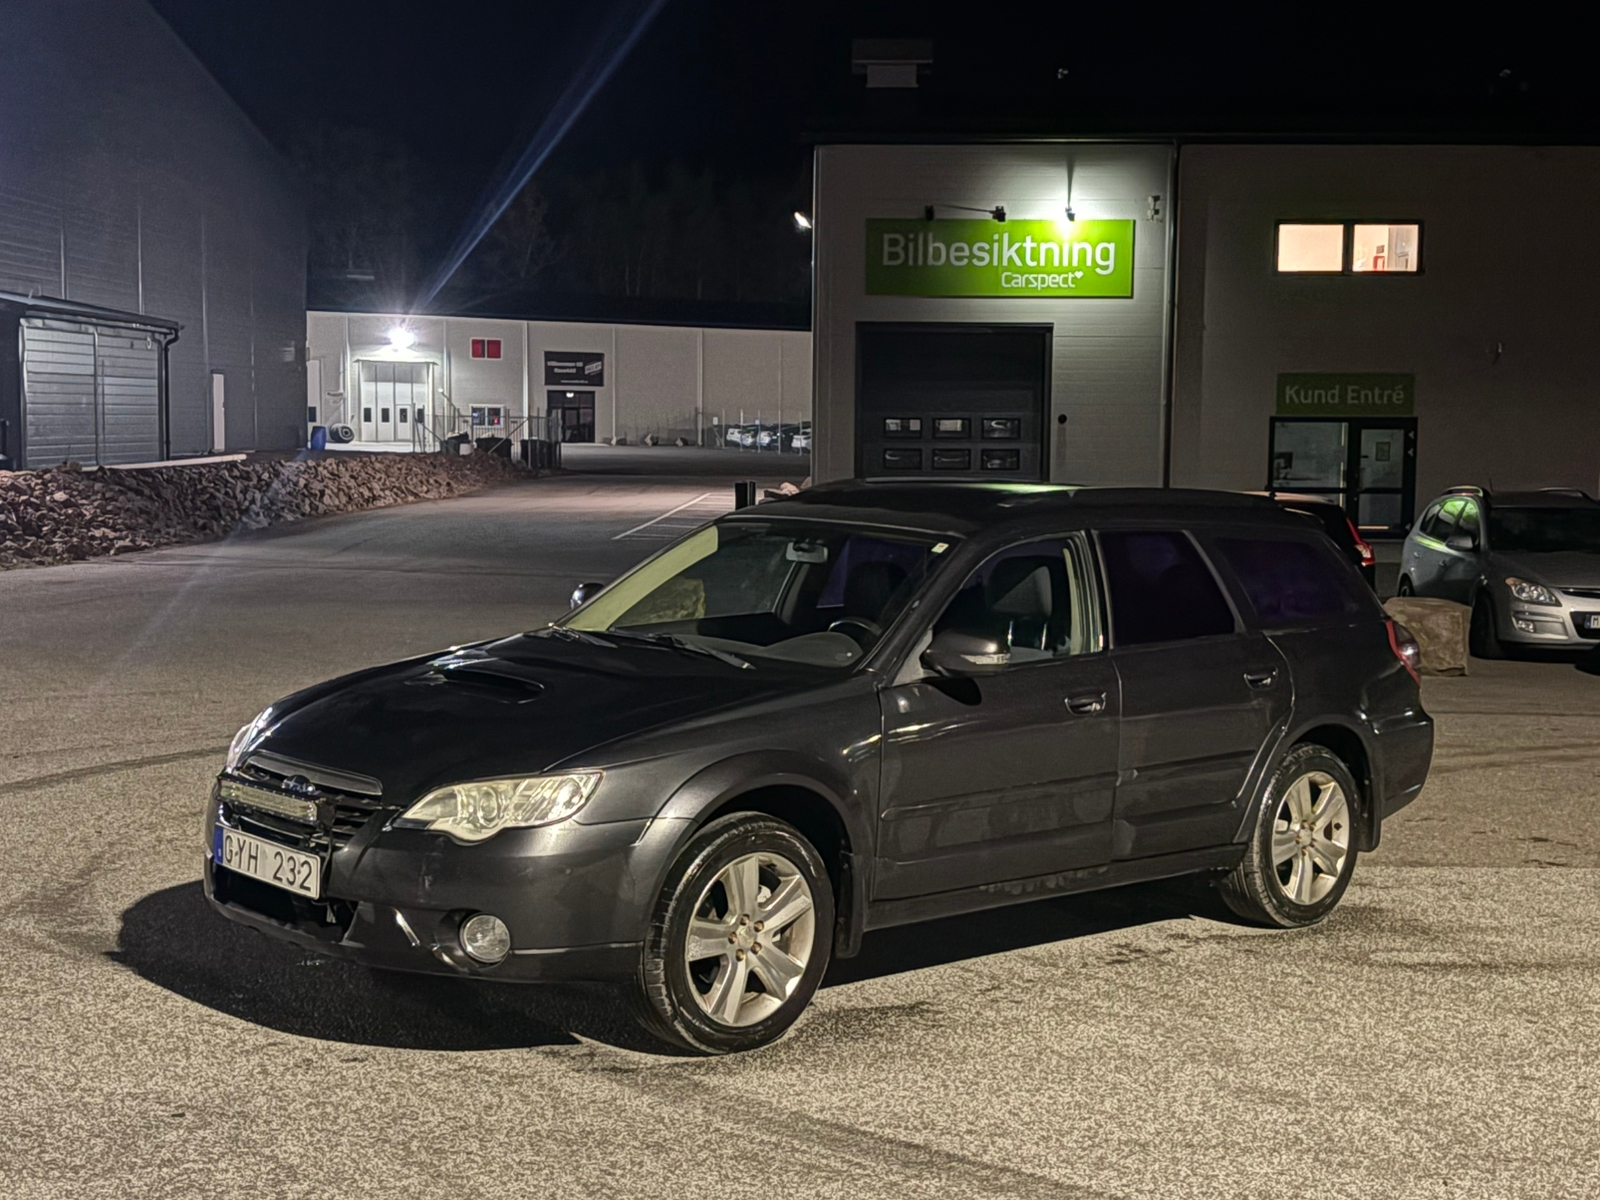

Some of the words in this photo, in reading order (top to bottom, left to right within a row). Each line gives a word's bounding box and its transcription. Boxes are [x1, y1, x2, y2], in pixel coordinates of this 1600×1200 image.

[882, 232, 1115, 275] Bilbesiktning
[1001, 271, 1076, 290] Carspect
[1285, 385, 1339, 404] Kund
[1347, 384, 1404, 404] Entré
[224, 834, 259, 875] GYH
[273, 851, 312, 892] 232
